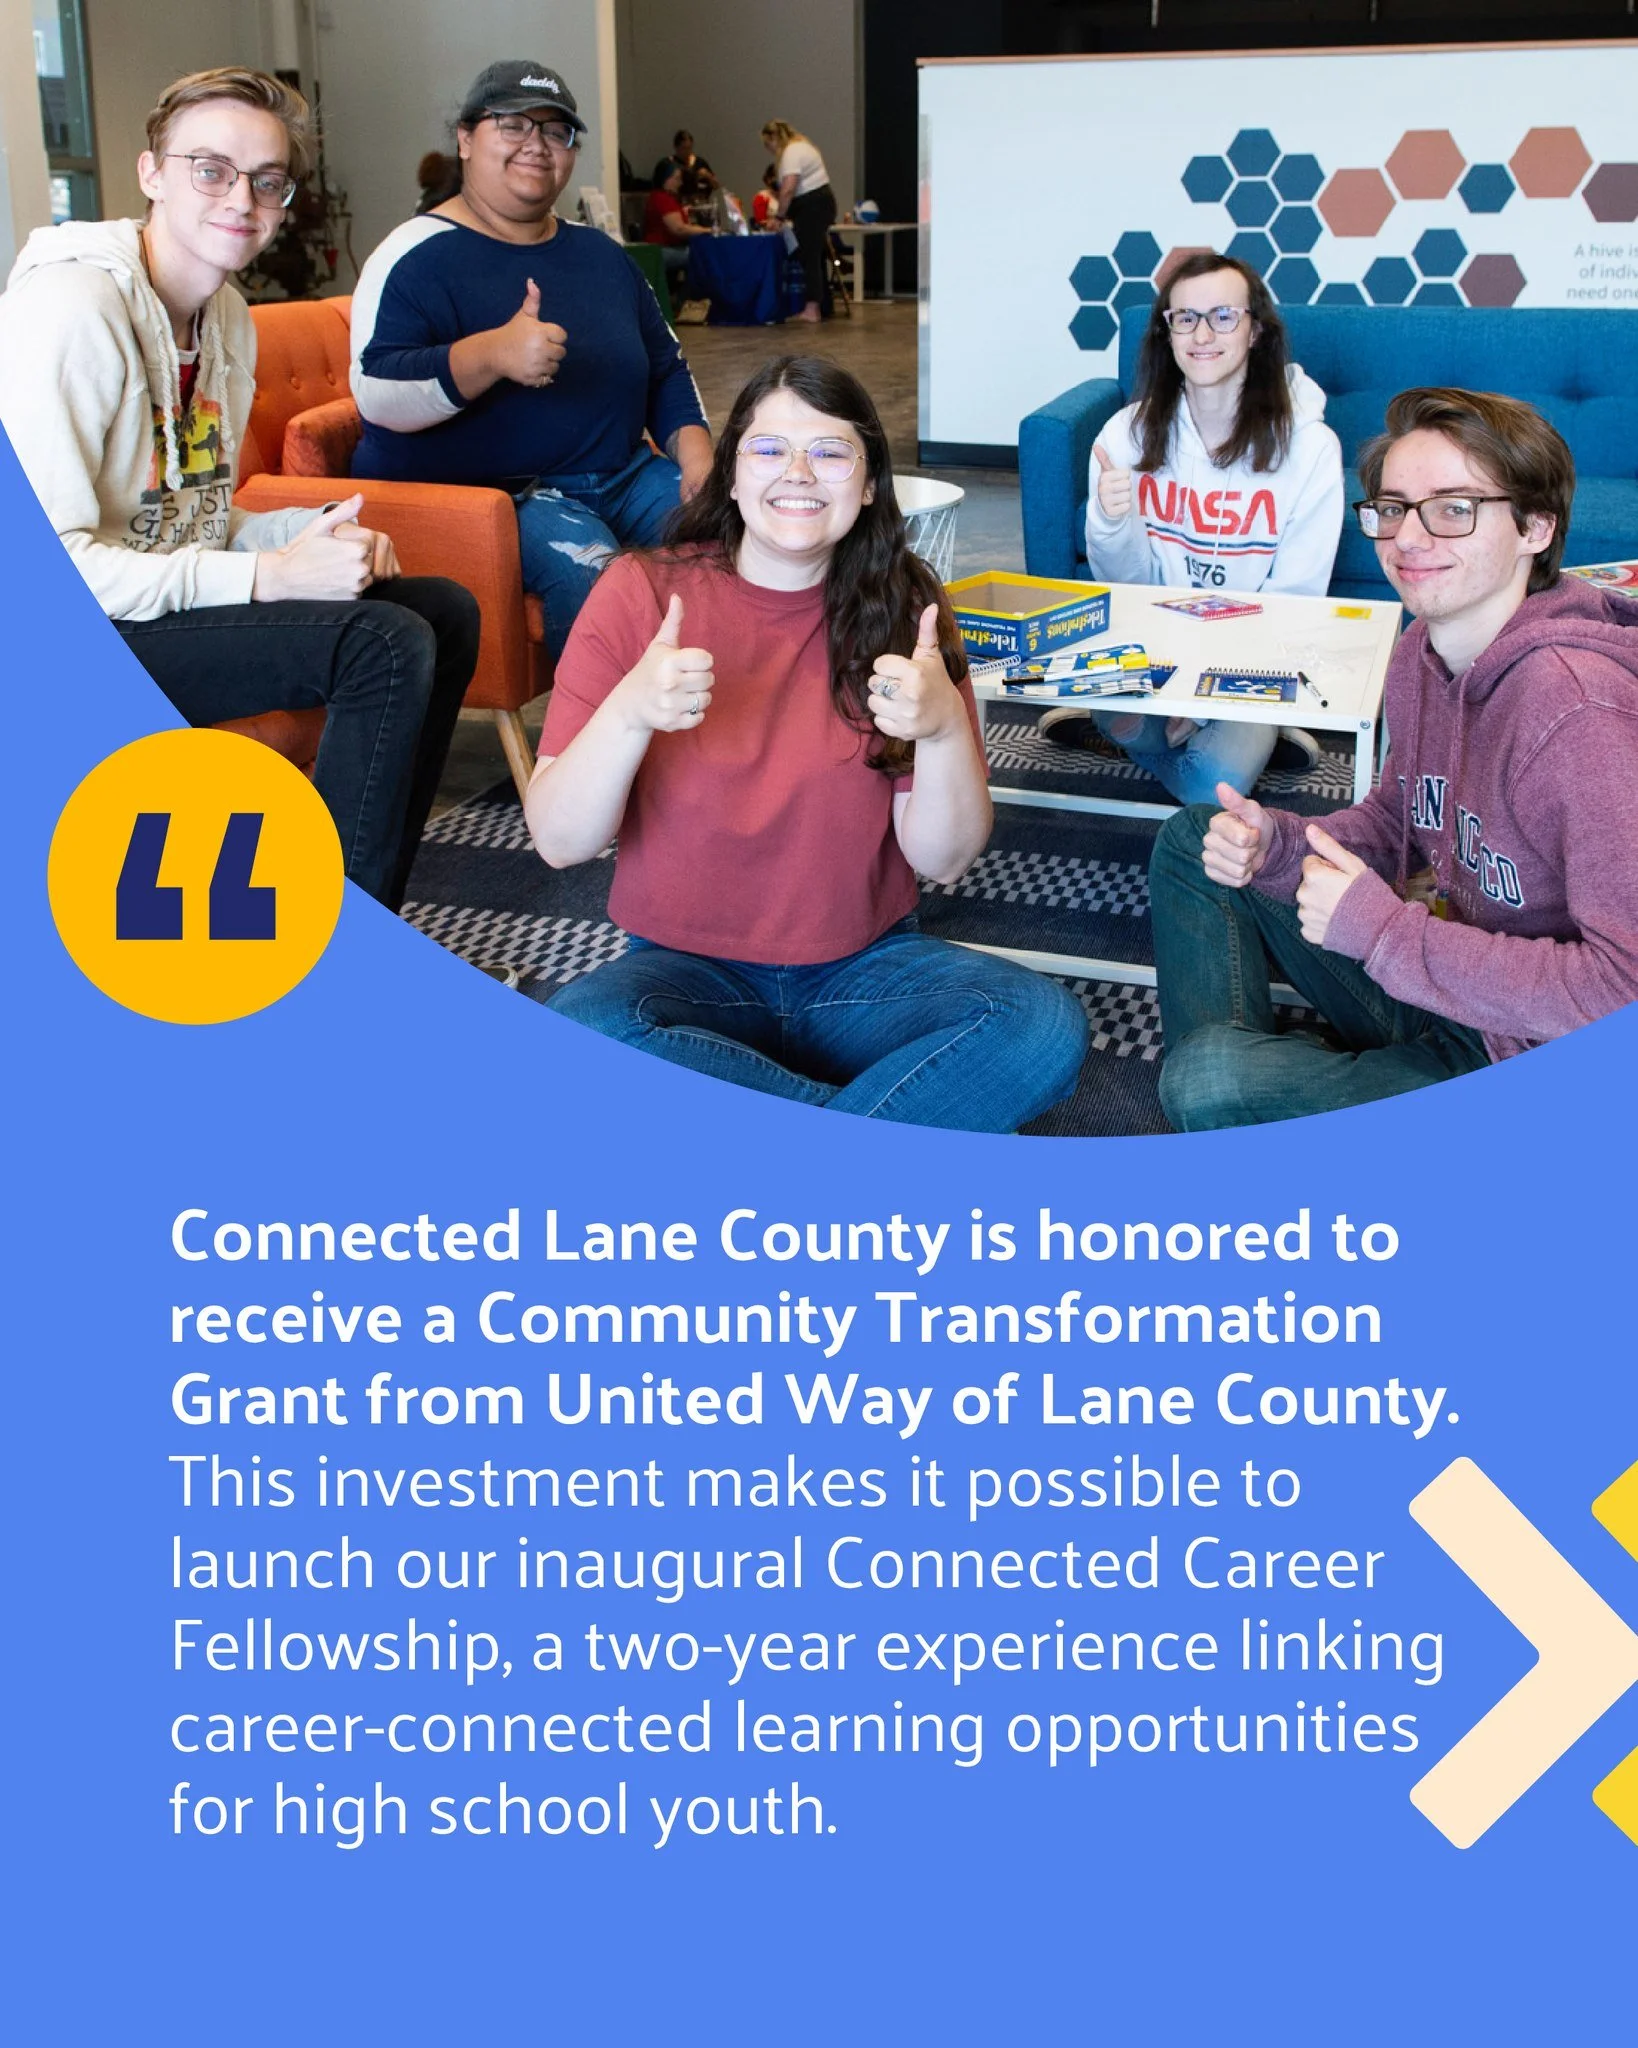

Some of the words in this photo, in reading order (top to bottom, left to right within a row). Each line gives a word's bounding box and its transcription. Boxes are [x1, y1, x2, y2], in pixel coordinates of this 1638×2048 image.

[520, 75, 561, 94] daddy
[1574, 243, 1584, 258] A
[1590, 243, 1624, 258] hive
[1579, 263, 1596, 279] of
[1566, 285, 1608, 300] need
[1138, 473, 1278, 536] NASA
[1184, 555, 1226, 587] 1976
[1047, 609, 1105, 639] Telestrations
[1029, 638, 1038, 652] 6
